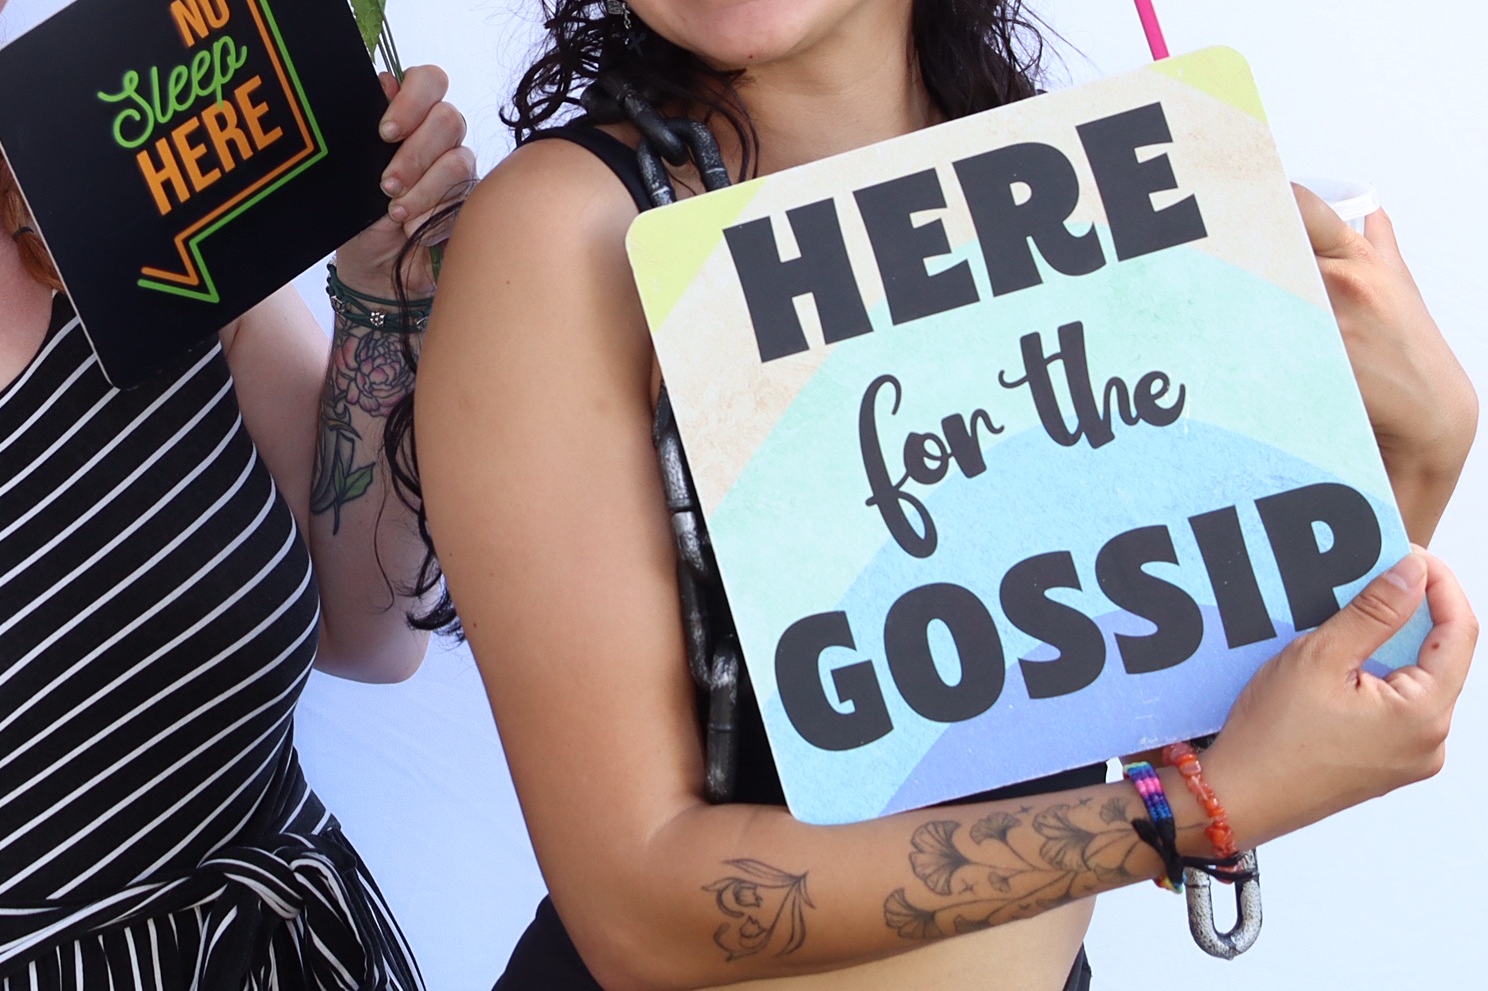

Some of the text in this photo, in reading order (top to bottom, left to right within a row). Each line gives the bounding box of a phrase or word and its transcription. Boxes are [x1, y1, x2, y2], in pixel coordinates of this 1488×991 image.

[97, 35, 247, 149] Sleep
[135, 75, 283, 216] HERE
[722, 101, 1208, 363] HERE
[858, 320, 1186, 558] for the
[774, 481, 1382, 751] GOSSIP
